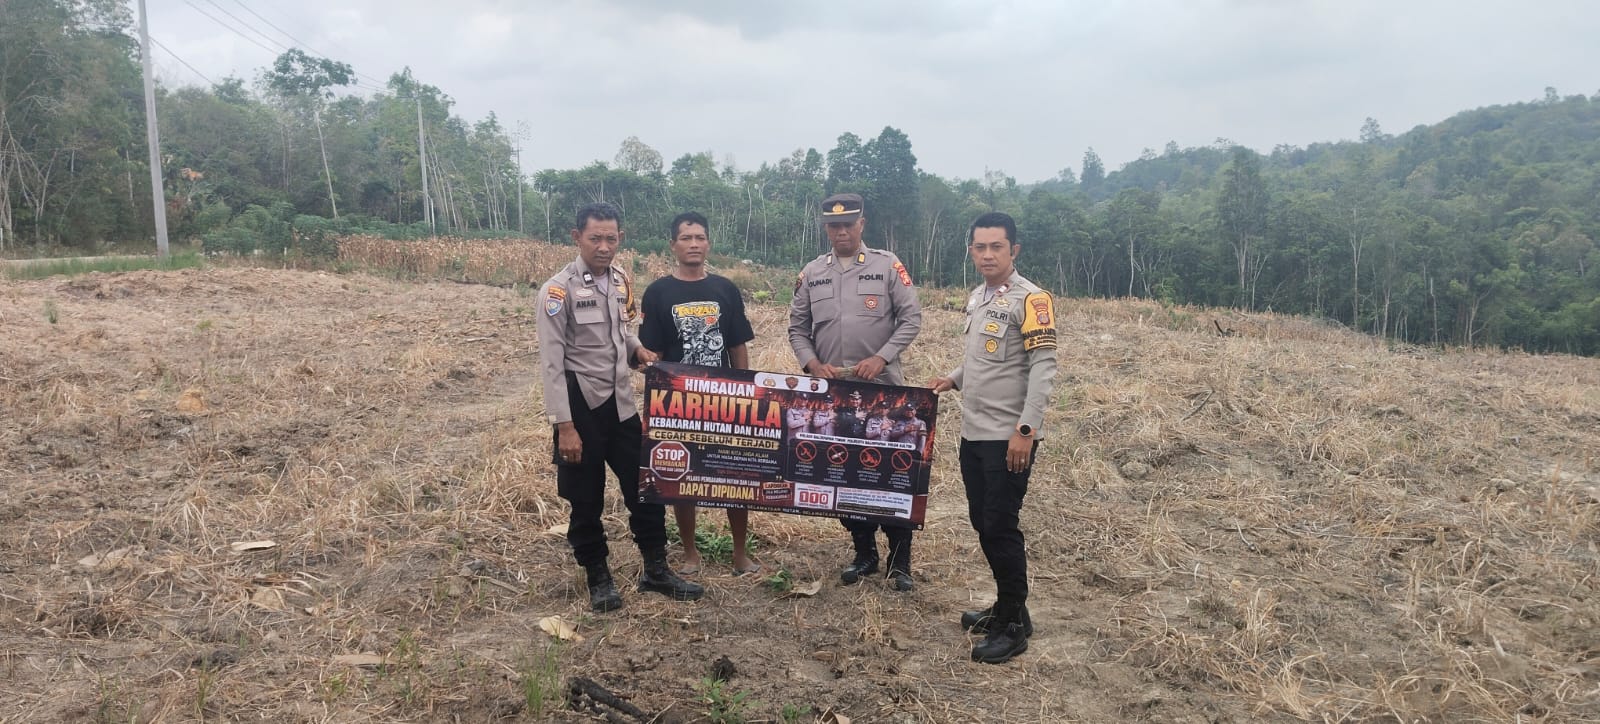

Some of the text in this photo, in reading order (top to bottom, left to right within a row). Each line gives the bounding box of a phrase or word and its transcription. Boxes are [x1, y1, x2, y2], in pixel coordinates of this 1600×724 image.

[986, 309, 1008, 321] POLRI
[685, 378, 755, 397] HIMBAUAN
[650, 389, 781, 428] KARHUTLA
[649, 417, 782, 439] KEBAKARAN HUTAN DAN LAHAN
[654, 431, 774, 448] CEGAH SEBELUM TERJADI
[656, 449, 685, 461] STOP
[679, 482, 710, 497] DAPAT
[711, 485, 754, 500] DIPIDANA
